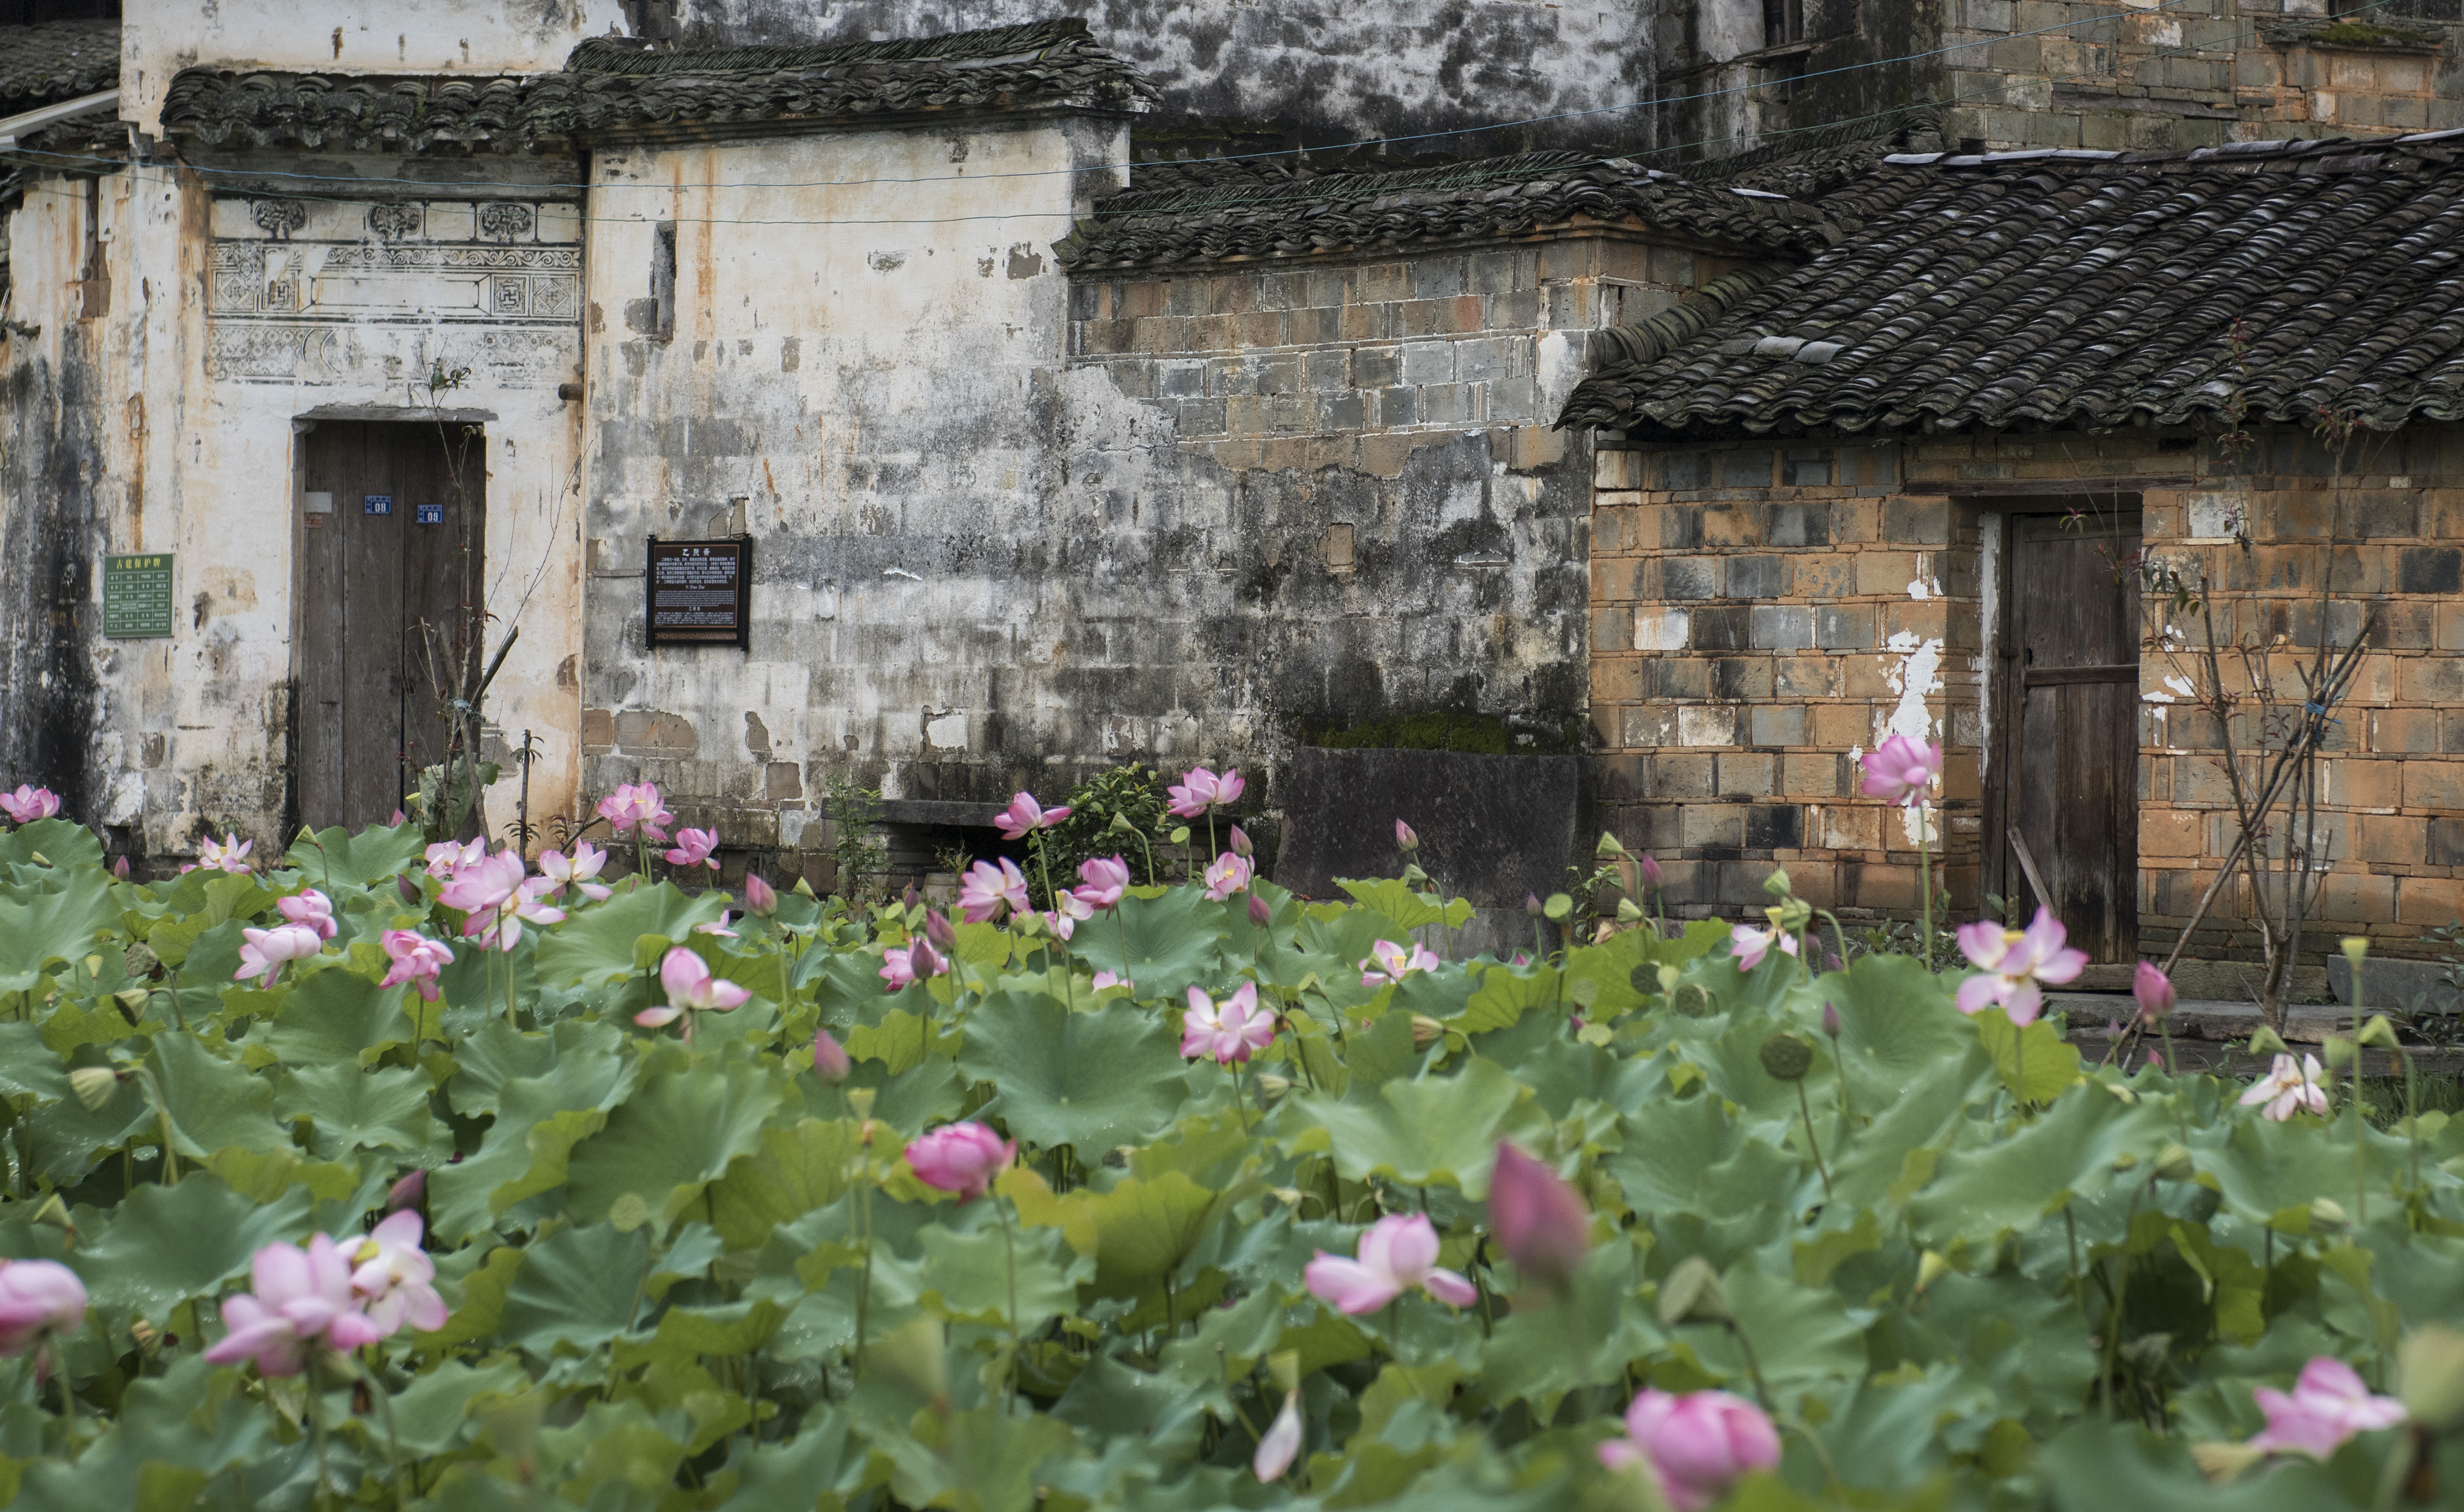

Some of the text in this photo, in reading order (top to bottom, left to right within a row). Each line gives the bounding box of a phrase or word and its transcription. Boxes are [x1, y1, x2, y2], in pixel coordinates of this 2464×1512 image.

[375, 503, 386, 512] 08
[428, 512, 438, 521] 09
[117, 558, 161, 569] 古建保护牌
